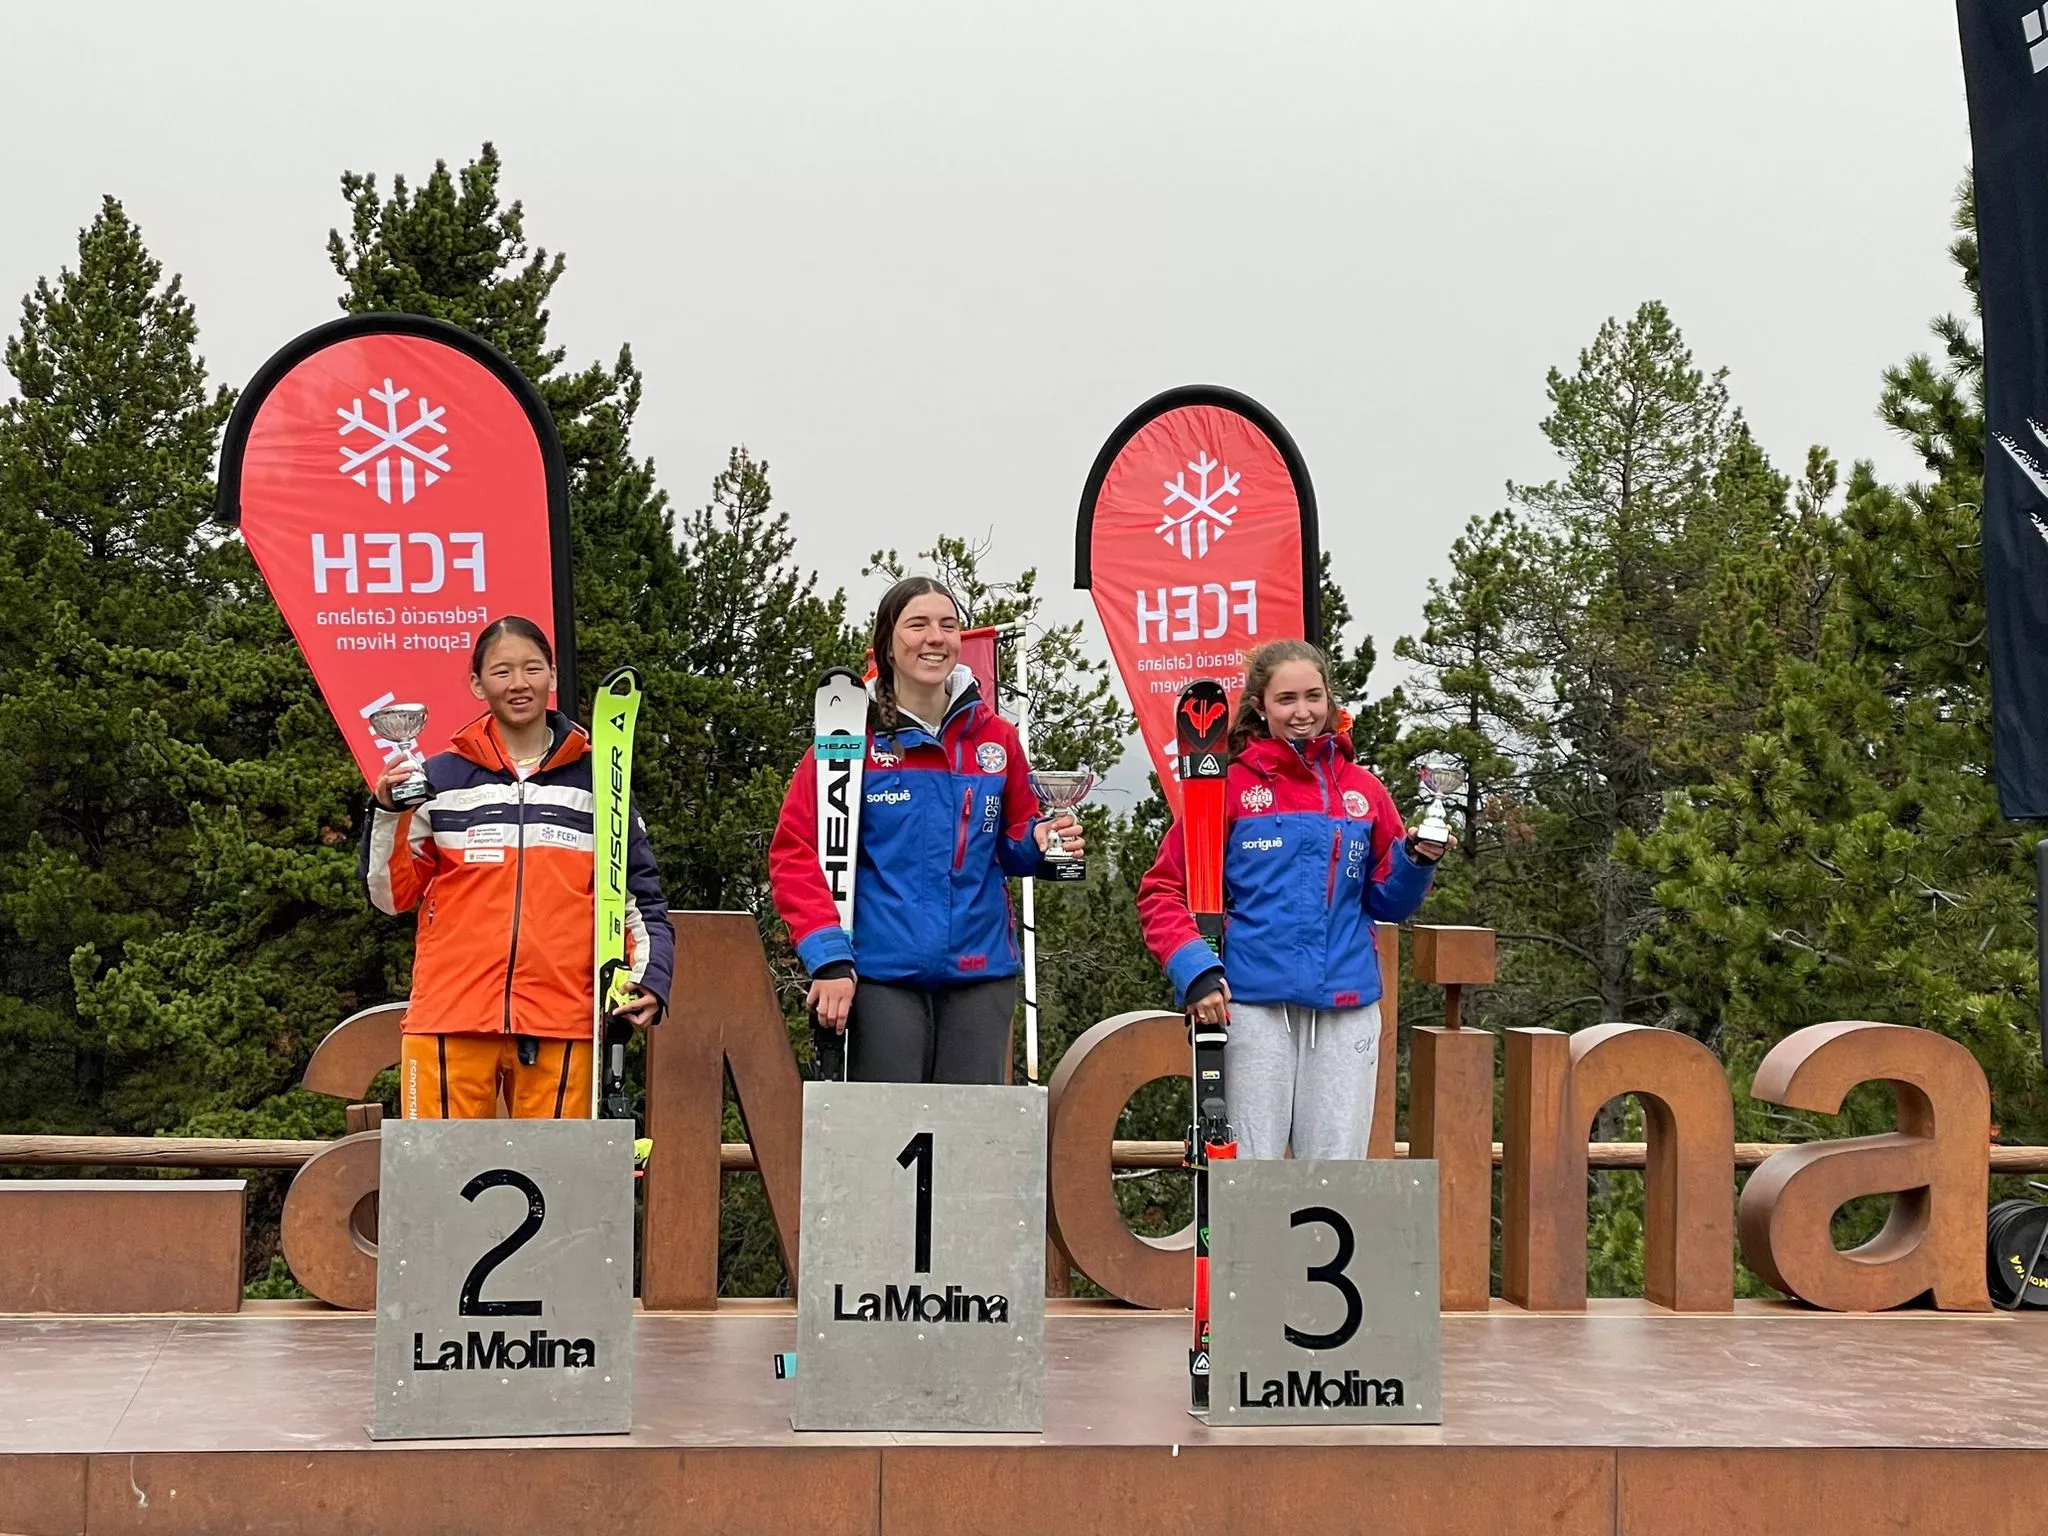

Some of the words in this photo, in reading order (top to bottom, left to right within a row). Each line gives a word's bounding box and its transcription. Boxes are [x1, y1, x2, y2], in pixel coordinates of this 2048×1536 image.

[817, 742, 861, 750] HEAD
[557, 831, 577, 843] FCEH
[609, 745, 623, 895] FISCHER
[458, 1168, 546, 1316] 2
[896, 1132, 933, 1274] 1
[1284, 1206, 1364, 1350] 3
